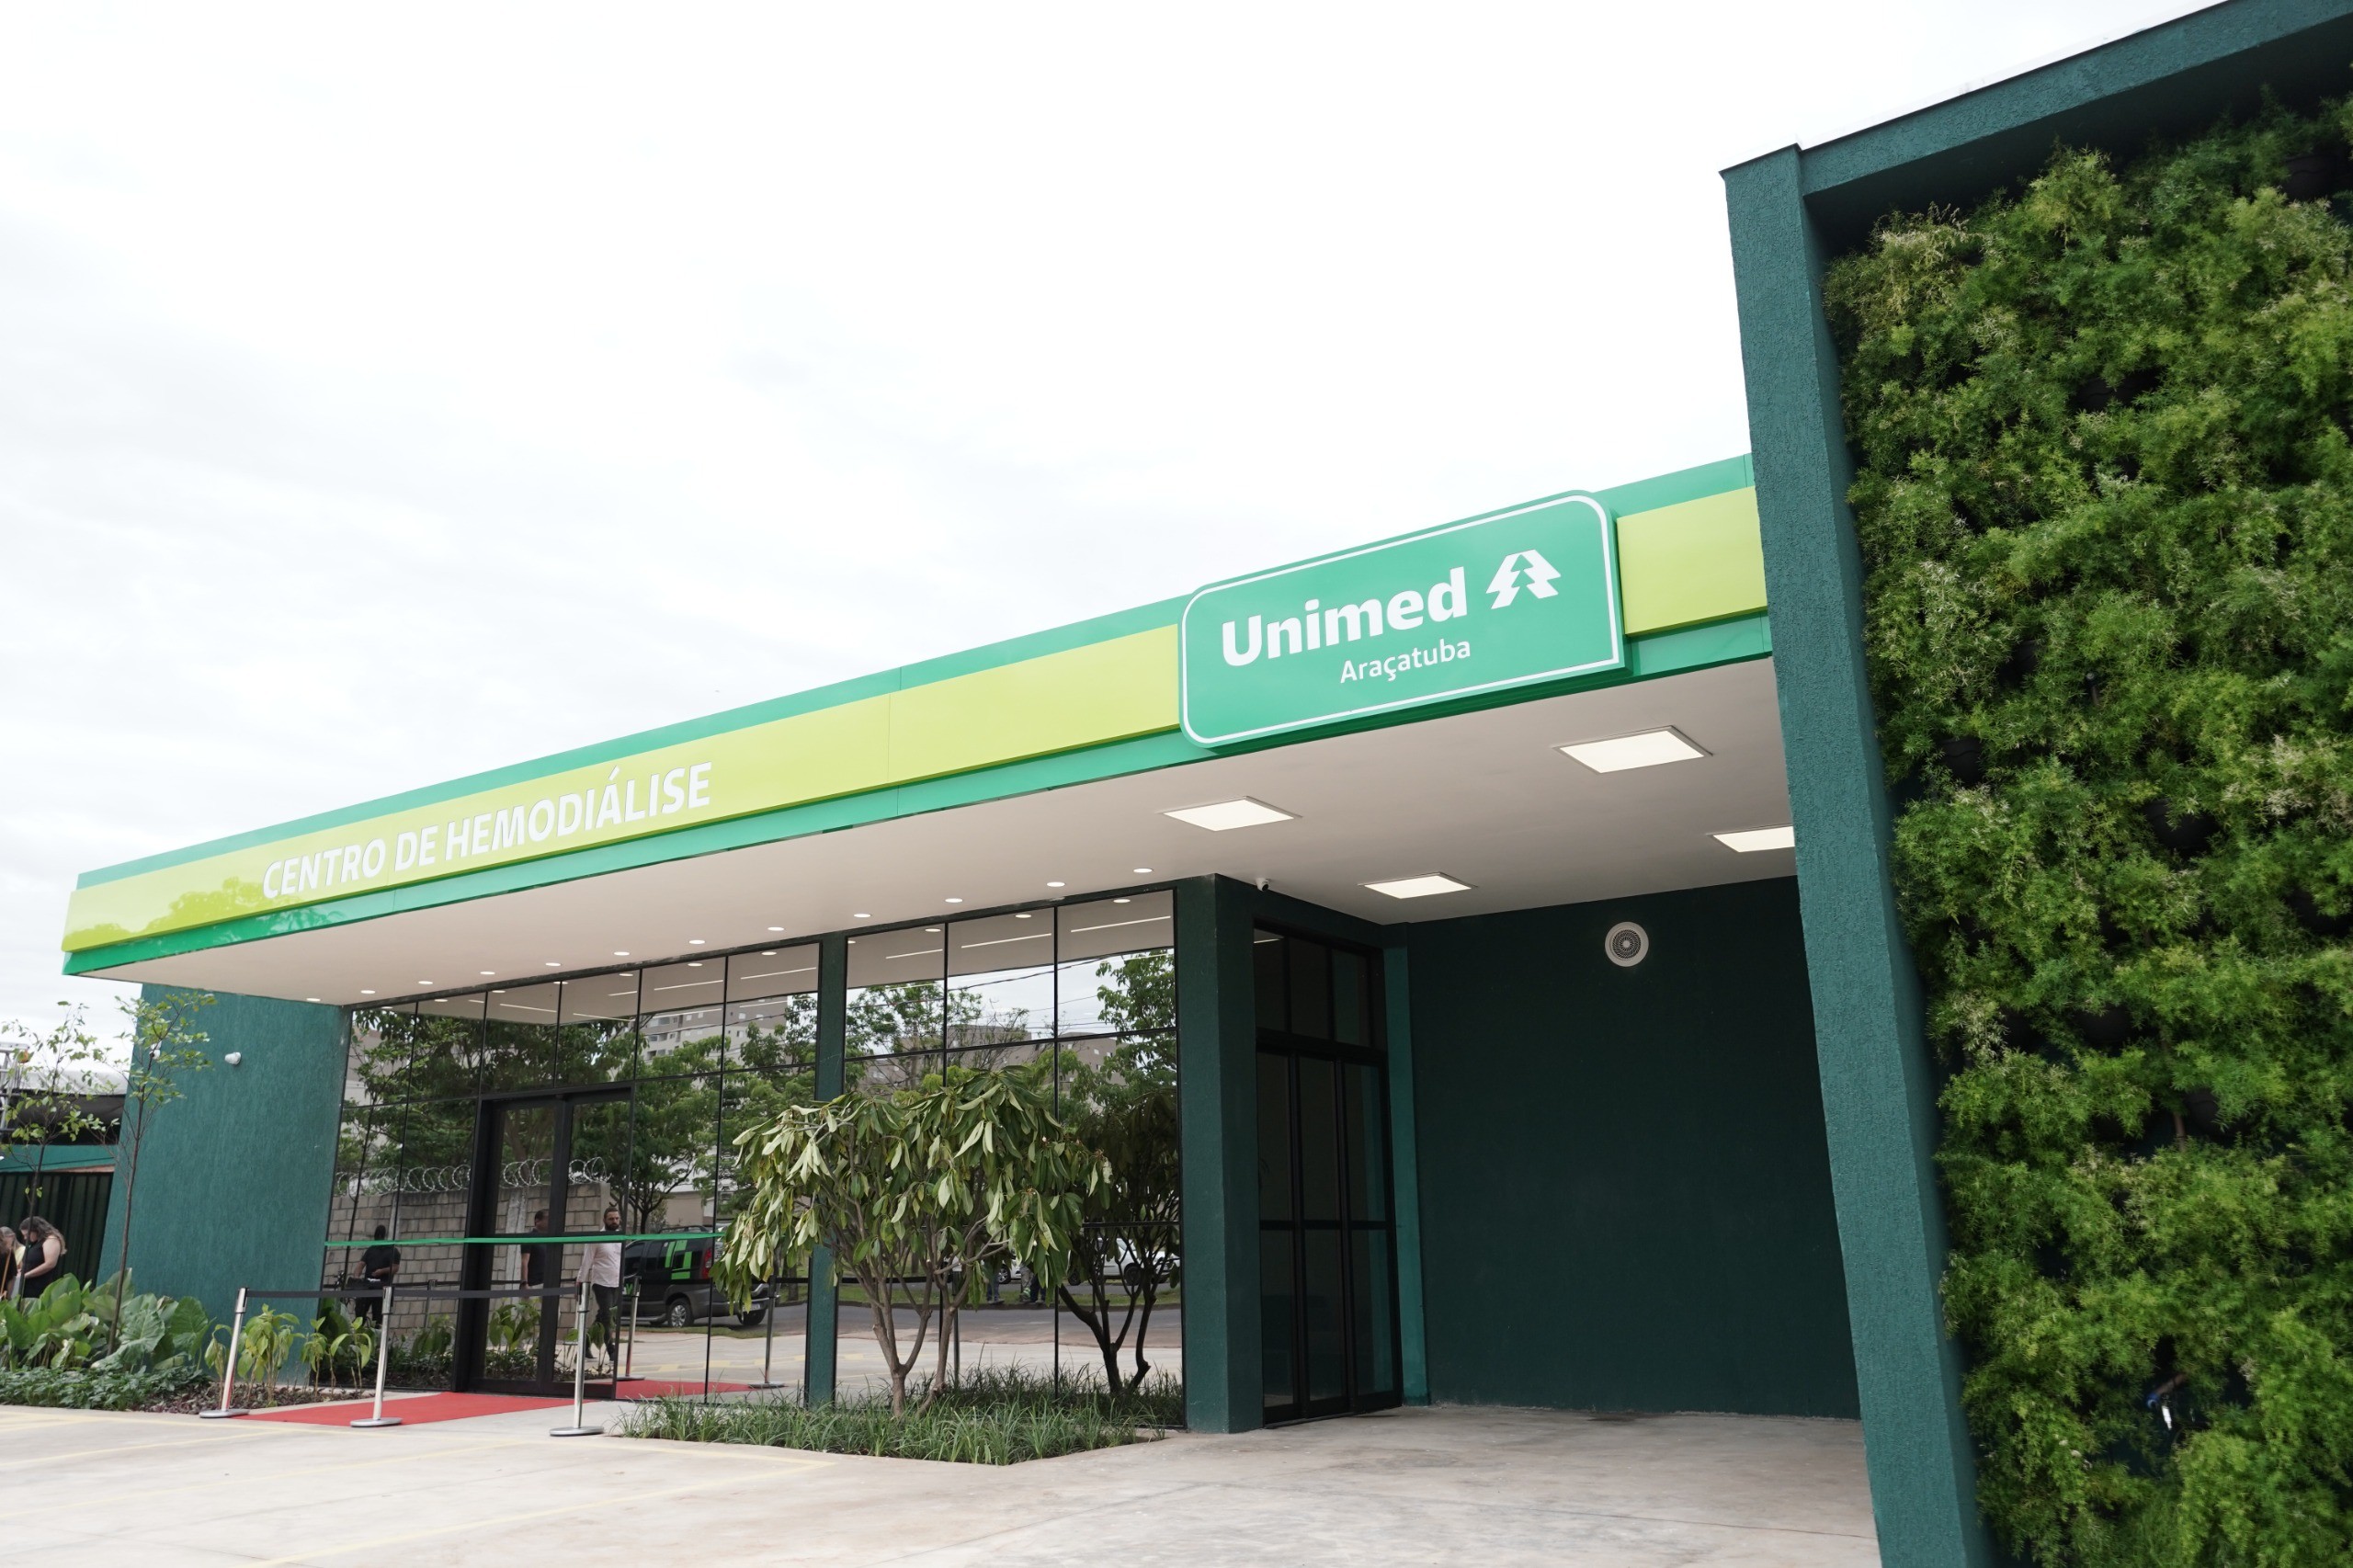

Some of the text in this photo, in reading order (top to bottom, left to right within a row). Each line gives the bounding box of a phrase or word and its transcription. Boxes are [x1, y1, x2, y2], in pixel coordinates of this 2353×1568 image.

[1222, 566, 1468, 666] Unimed
[1339, 639, 1471, 683] Araçatuba
[263, 762, 711, 899] CENTRO DE HEMODIÁLISE
